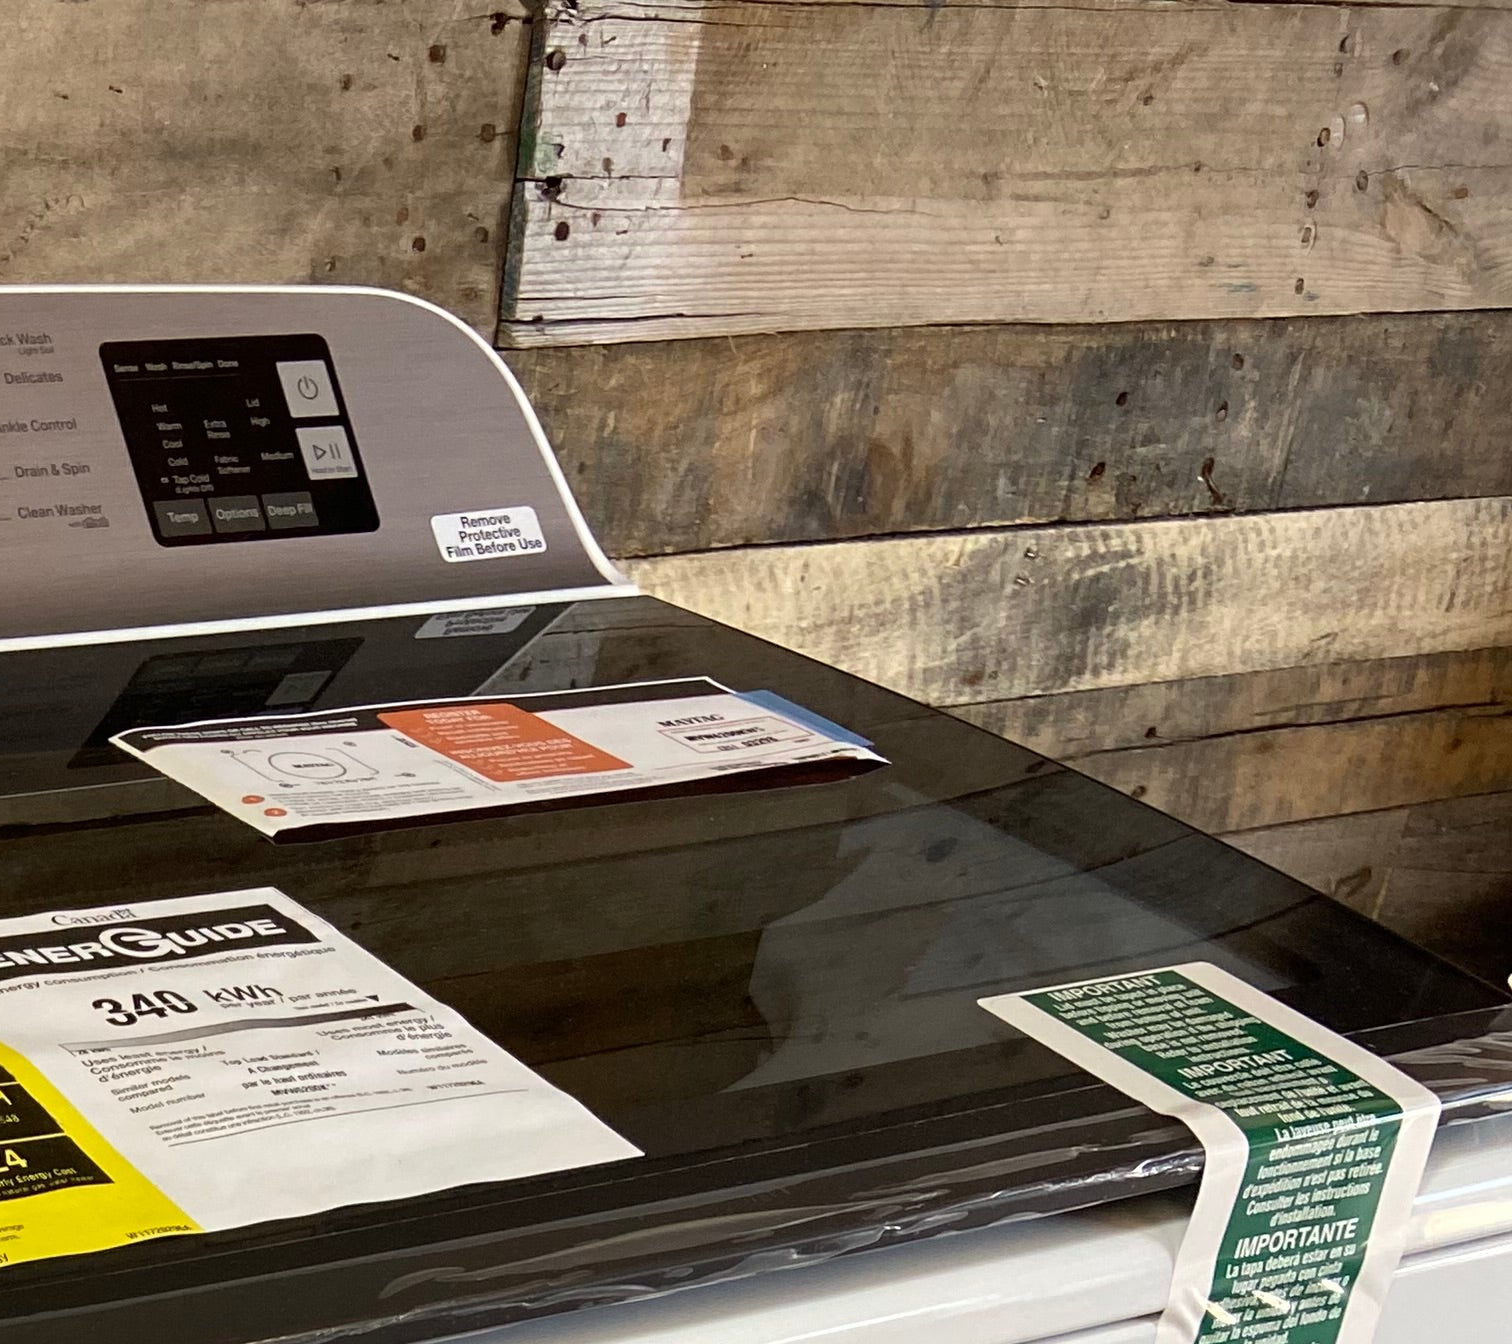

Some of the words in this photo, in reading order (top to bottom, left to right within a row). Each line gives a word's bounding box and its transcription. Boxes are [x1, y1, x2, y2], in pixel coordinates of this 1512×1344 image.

[18, 334, 52, 344] Wash
[4, 372, 63, 384] Delicates
[152, 404, 168, 412] Hot
[246, 399, 259, 407] Lid
[31, 419, 77, 431] Control
[157, 422, 182, 430] Warm
[250, 417, 270, 426] High
[163, 440, 183, 449] Cool
[168, 457, 188, 466] Cold
[261, 451, 294, 461] Medium
[15, 466, 48, 478] Drain
[51, 465, 59, 475] &
[62, 463, 89, 476] Spin
[173, 475, 187, 484] Tap
[189, 474, 210, 483] Cold
[18, 507, 54, 519] Clean
[57, 504, 102, 516] Washer
[216, 508, 259, 521] Options
[268, 505, 296, 516] Deep
[298, 503, 312, 513] Fill
[168, 512, 199, 523] Temp
[460, 514, 511, 528] Remove
[459, 527, 521, 542] Protective
[446, 546, 473, 558] Film
[477, 540, 516, 555] Before
[519, 538, 542, 549] Use
[657, 713, 724, 728] MAYTAG
[52, 909, 137, 927] Canada
[1048, 975, 1163, 1002] IMPORTANT
[92, 990, 198, 1026] 340
[203, 983, 282, 1003] kWh
[1177, 1049, 1293, 1079] IMPORTANT
[99, 1064, 162, 1083] d'énergie
[16, 1170, 52, 1183] Energy
[54, 1168, 77, 1176] Cost
[1234, 1218, 1359, 1259] IMPORTANTE
[1226, 1264, 1238, 1278] La
[1241, 1260, 1263, 1276] tapa
[1265, 1250, 1301, 1270] deberá
[1302, 1247, 1327, 1262] estar
[1330, 1246, 1341, 1258] en
[1343, 1244, 1356, 1256] su
